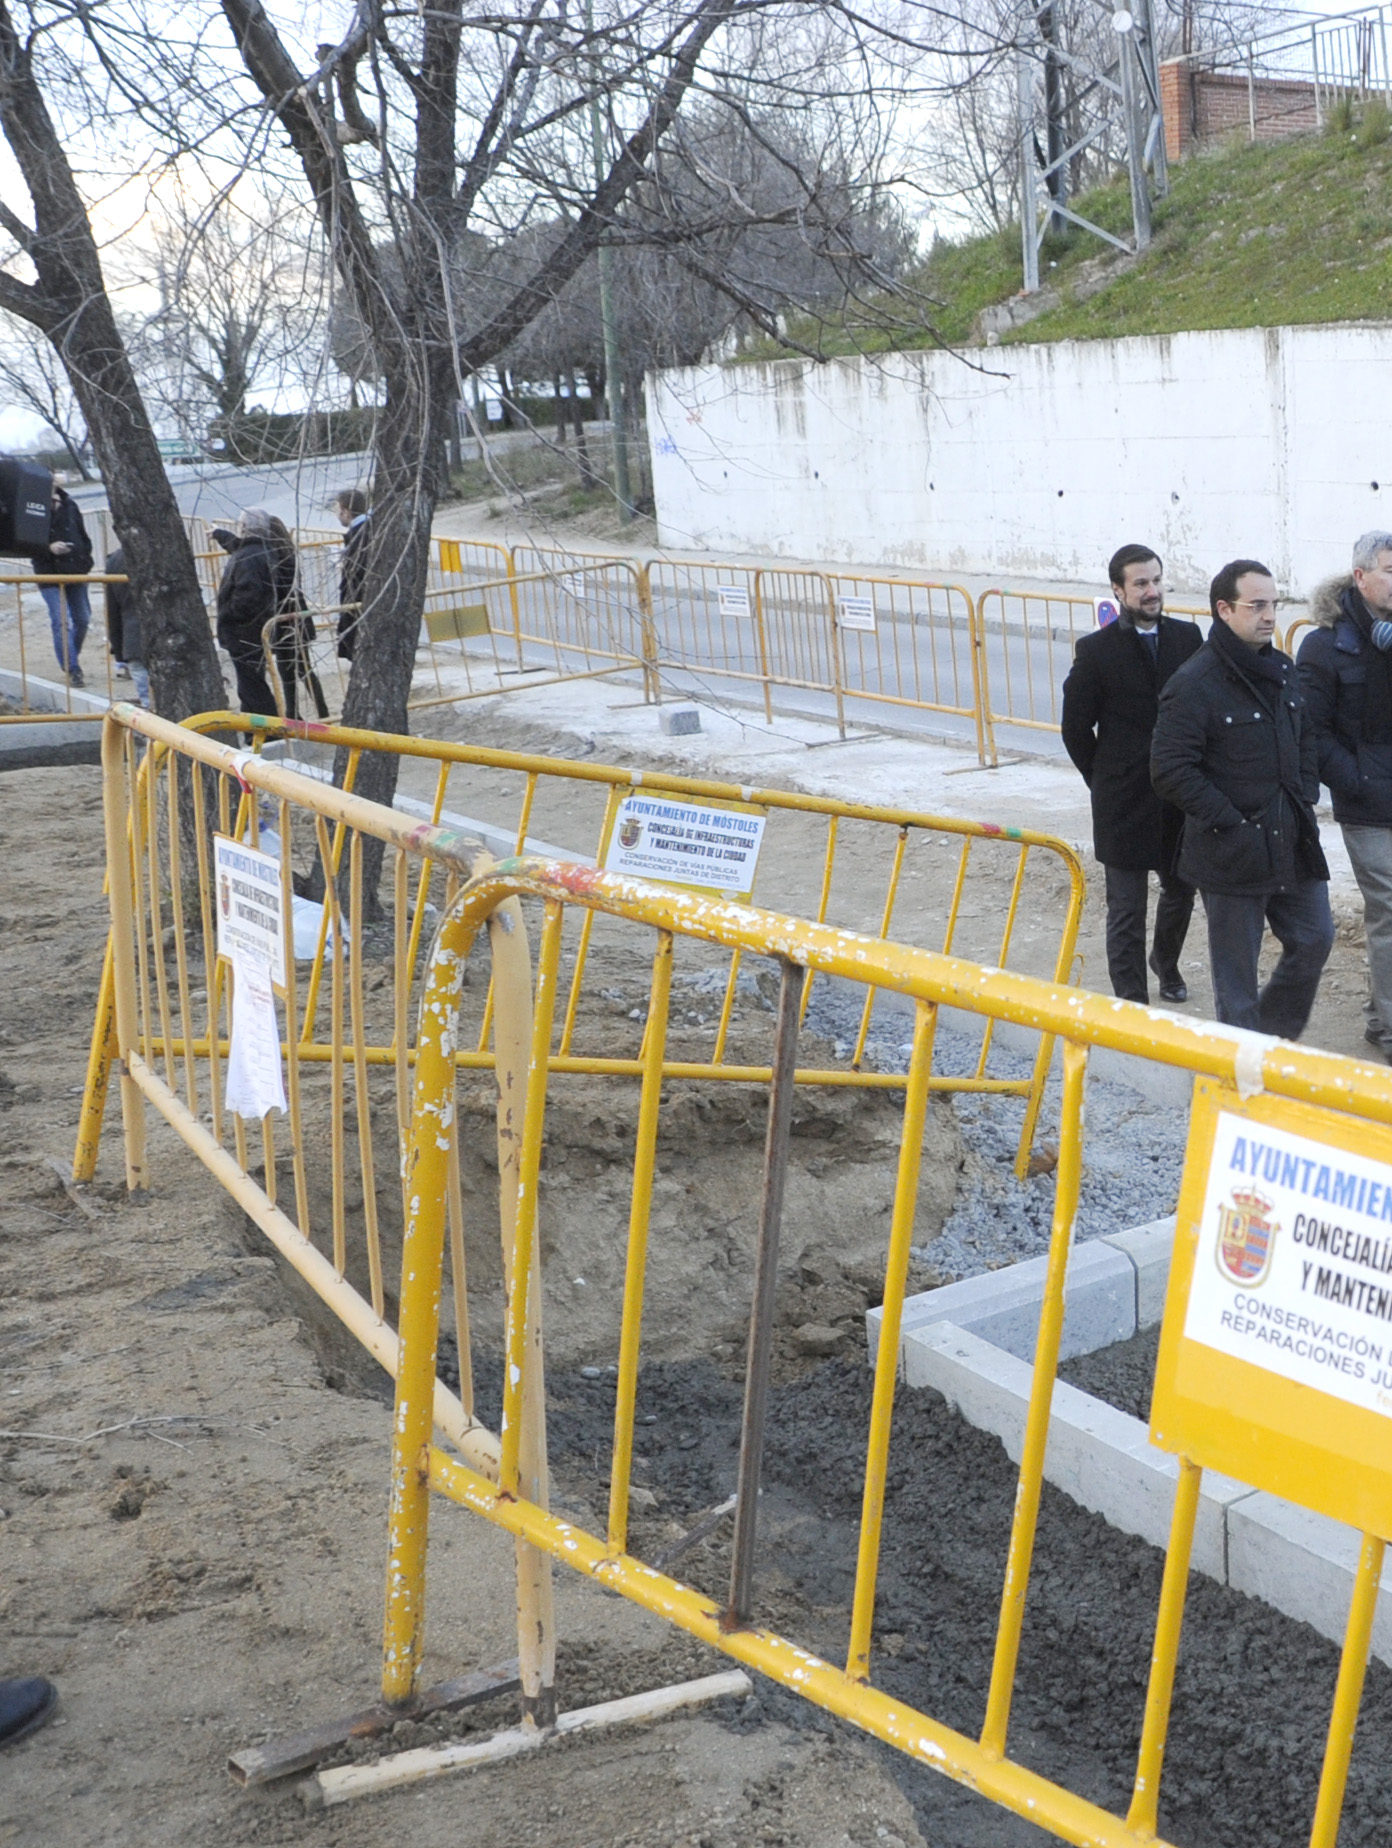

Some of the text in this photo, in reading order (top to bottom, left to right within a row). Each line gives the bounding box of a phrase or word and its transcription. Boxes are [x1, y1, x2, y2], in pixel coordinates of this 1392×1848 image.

[624, 800, 759, 834] AYUNTAMIENTO DE MÓSTOLES
[1301, 1260, 1313, 1291] Y
[1220, 1309, 1366, 1379] REPARACIONES
[1234, 1293, 1383, 1361] CONSERVACIÓN
